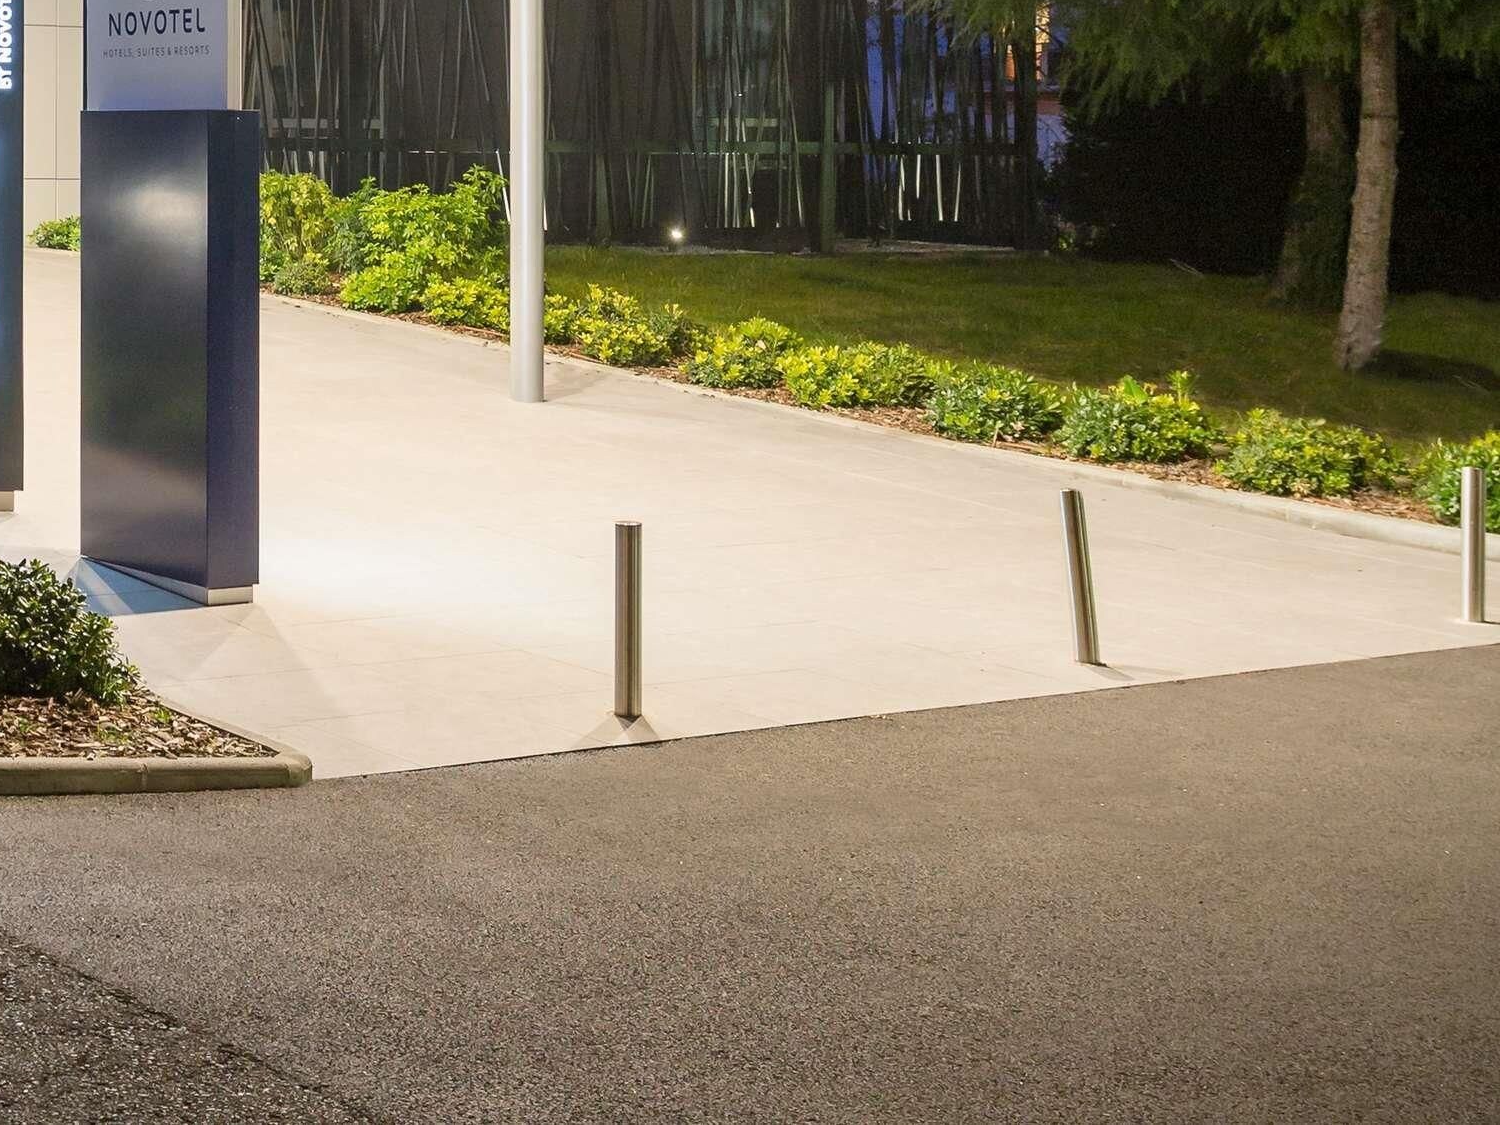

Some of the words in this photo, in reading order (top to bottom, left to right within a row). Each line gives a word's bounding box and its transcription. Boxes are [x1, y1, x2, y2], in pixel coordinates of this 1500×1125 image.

[108, 7, 205, 36] NOVOTEL
[138, 46, 165, 57] SUITES
[167, 45, 173, 56] &
[174, 44, 210, 56] RESORTS
